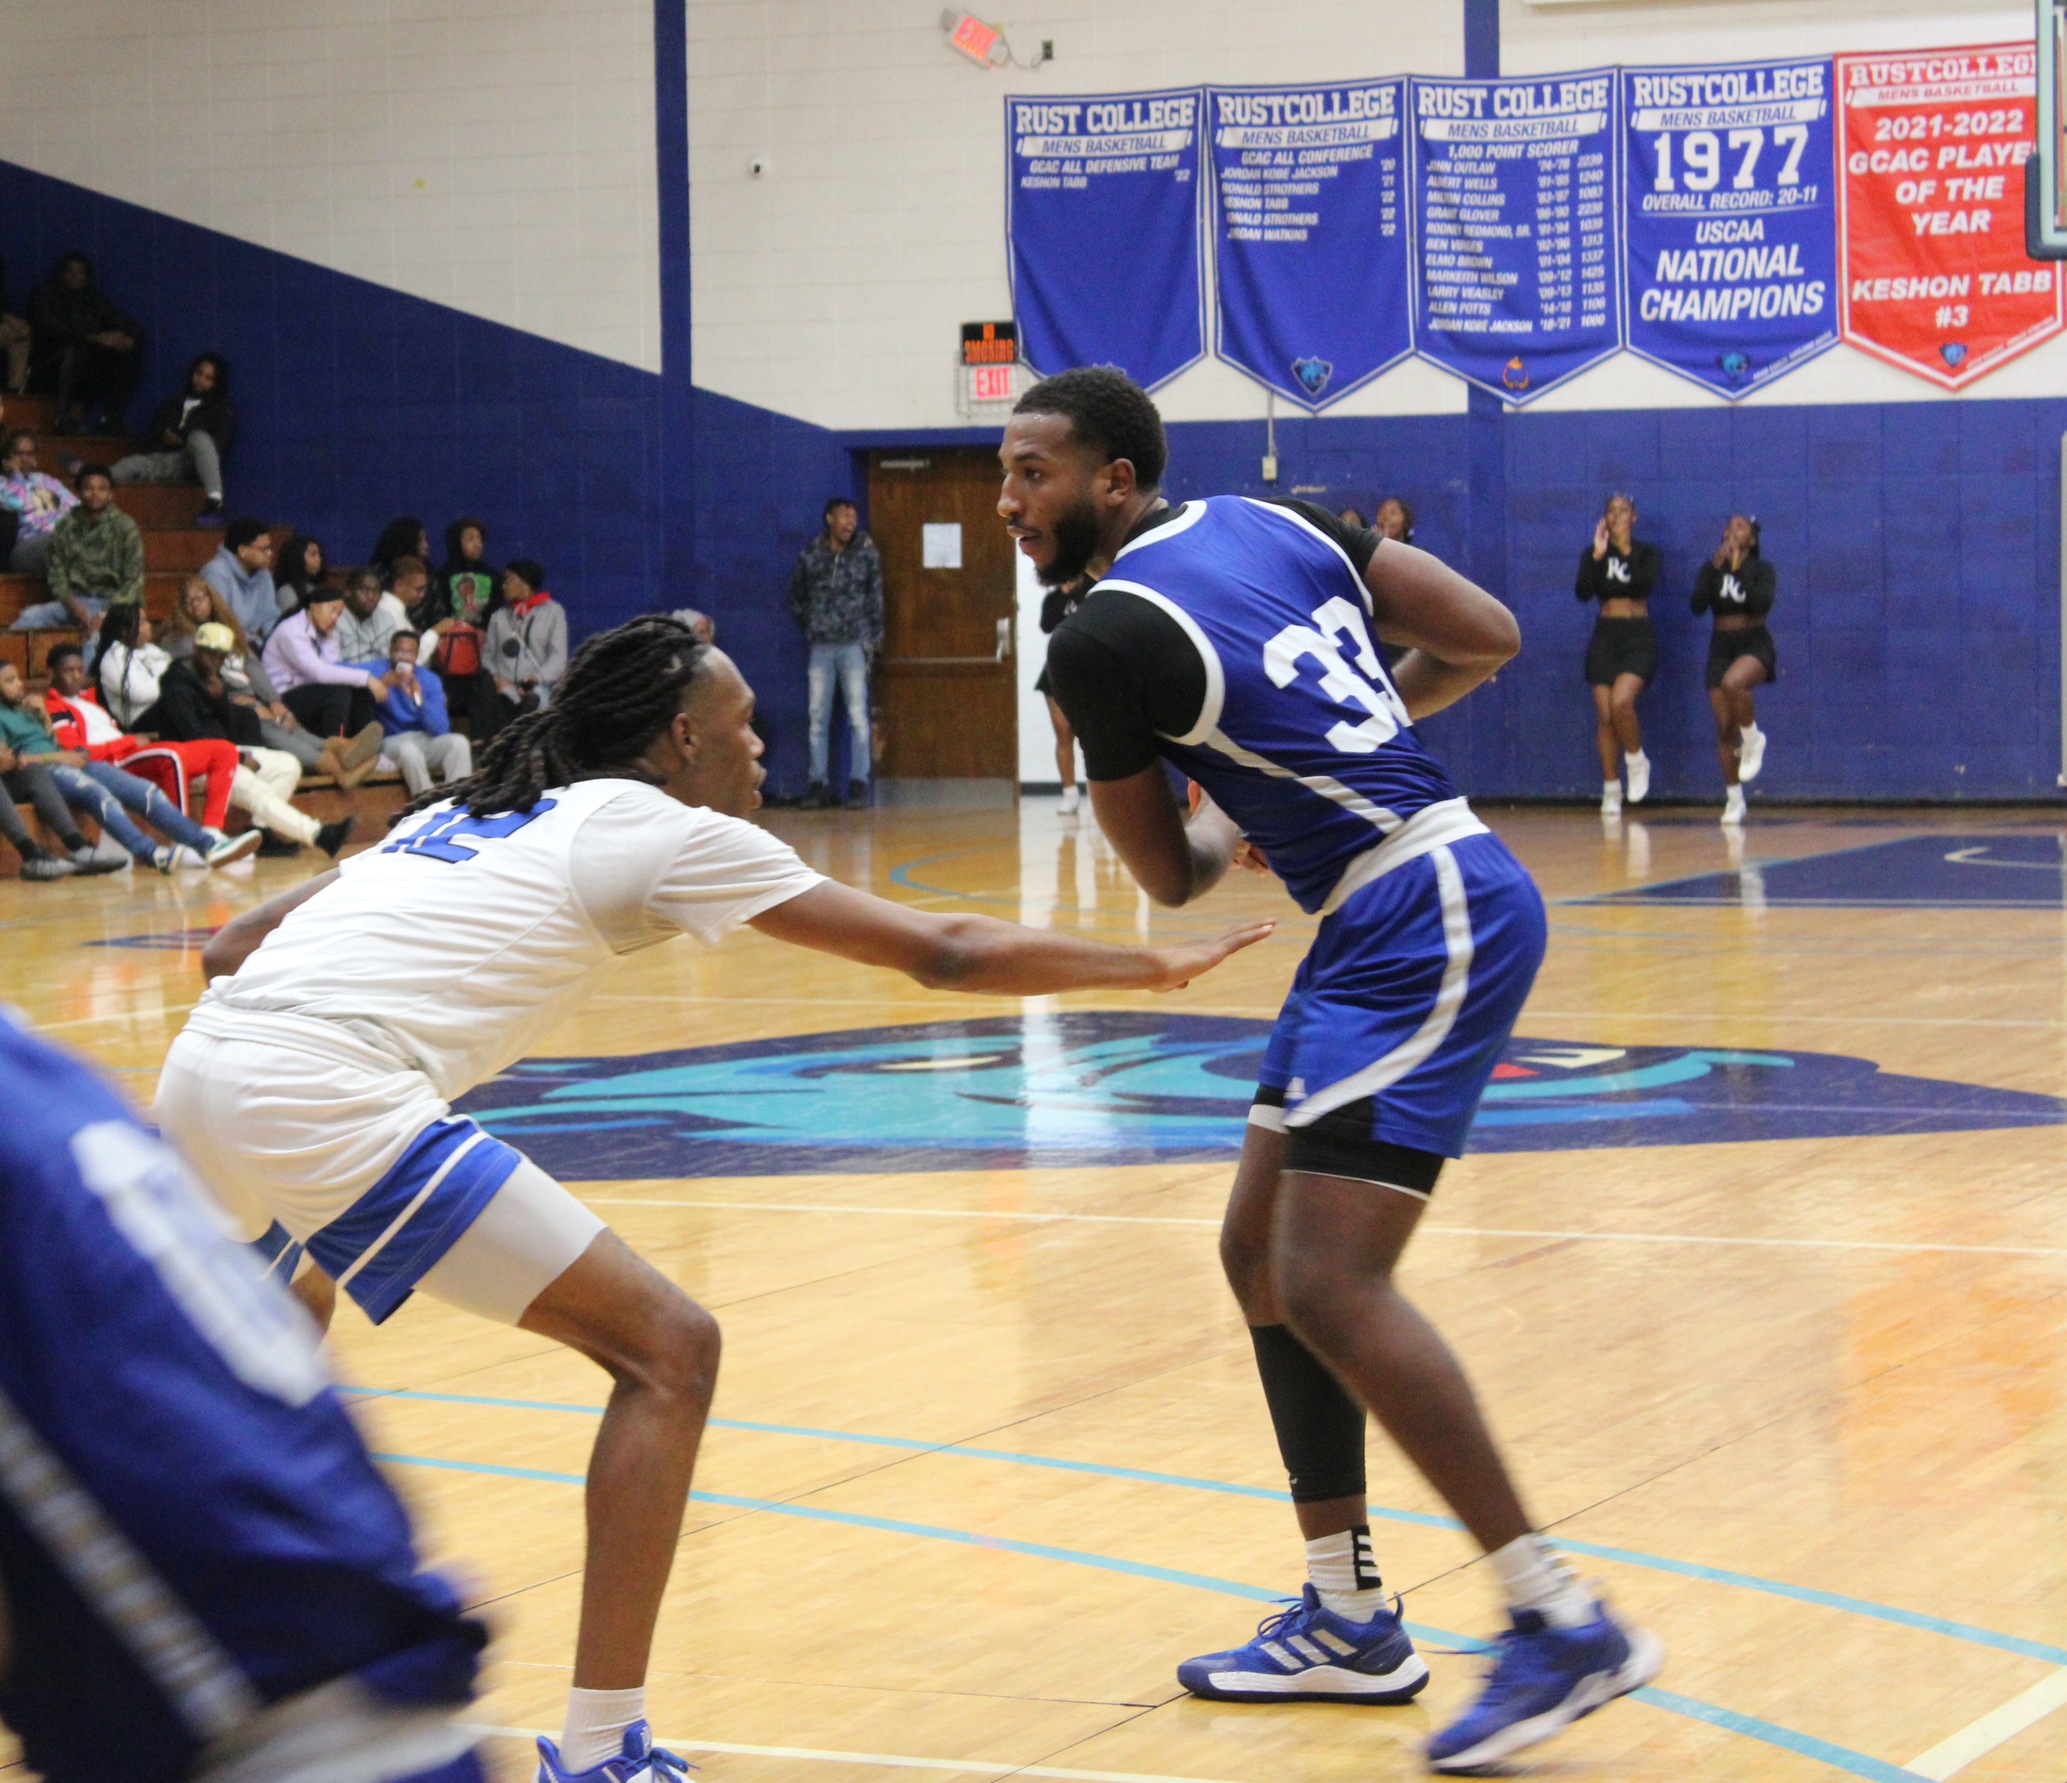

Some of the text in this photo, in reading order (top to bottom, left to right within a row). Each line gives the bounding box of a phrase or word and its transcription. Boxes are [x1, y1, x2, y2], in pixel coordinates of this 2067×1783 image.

[1418, 78, 1609, 117] RUST COLLEGE
[1878, 83, 2018, 100] MENS BASKETBALL
[1016, 97, 1196, 134] RUST COLLEGE
[1660, 106, 1796, 127] MENS BASKETBALL
[1874, 109, 2024, 141] 2021-2022
[1242, 126, 1370, 145] MENS BASKETBALL
[1448, 119, 1578, 138] MENS BASKETBALL
[1042, 135, 1166, 153] MENS BASKETBALL
[1449, 140, 1579, 159] 1,000 POINT SCORER
[1030, 154, 1180, 174] GCAC ALL DEFENSIVE TEAM
[1241, 144, 1374, 165] GCAC ALL CONFERENCE
[1654, 123, 1809, 191] 1977
[1849, 141, 2036, 175] GCAC PLAYE
[1221, 168, 1261, 180] JORDAN
[1263, 168, 1290, 180] KOBE
[1291, 166, 1338, 179] JACKSON
[1427, 160, 1452, 172] JOHN
[1454, 161, 1496, 175] OUTLAW
[1021, 177, 1059, 188] KESHON
[1063, 177, 1087, 188] TABB
[1263, 182, 1319, 195] STROTHERS
[1464, 177, 1497, 190] WELLS
[1895, 176, 2005, 204] OF THE
[1264, 198, 1289, 209] TABB
[1463, 193, 1505, 206] COLLINS
[1642, 185, 1817, 211] OVERALL RECORD: 20-11
[1263, 213, 1319, 225] STROTHERS
[1459, 208, 1499, 222] GLOVER
[1911, 209, 1991, 236] YEAR
[1264, 229, 1308, 241] WATKINS
[1695, 219, 1764, 243] USCAA
[1426, 238, 1448, 251] BEN
[1426, 254, 1456, 267] ELMO
[1457, 255, 1493, 269] BROWN
[1656, 243, 1804, 281] NATIONAL
[1426, 270, 1478, 284] MARKEITH
[1480, 272, 1518, 285] WILSON
[1852, 269, 2052, 301] KESHON TABB
[1428, 286, 1460, 298] LARRY
[1462, 287, 1504, 301] VEASLEY
[1641, 281, 1826, 321] CHAMPIONS
[1429, 301, 1456, 314] ALLEN
[1459, 303, 1491, 316] POTTS
[1935, 305, 1969, 329] #3
[1463, 319, 1488, 332] KOBE
[1489, 320, 1532, 333] JACKSON
[965, 339, 1013, 364] SMOKING
[976, 367, 1011, 399] EXIT
[1263, 595, 1415, 754] 33
